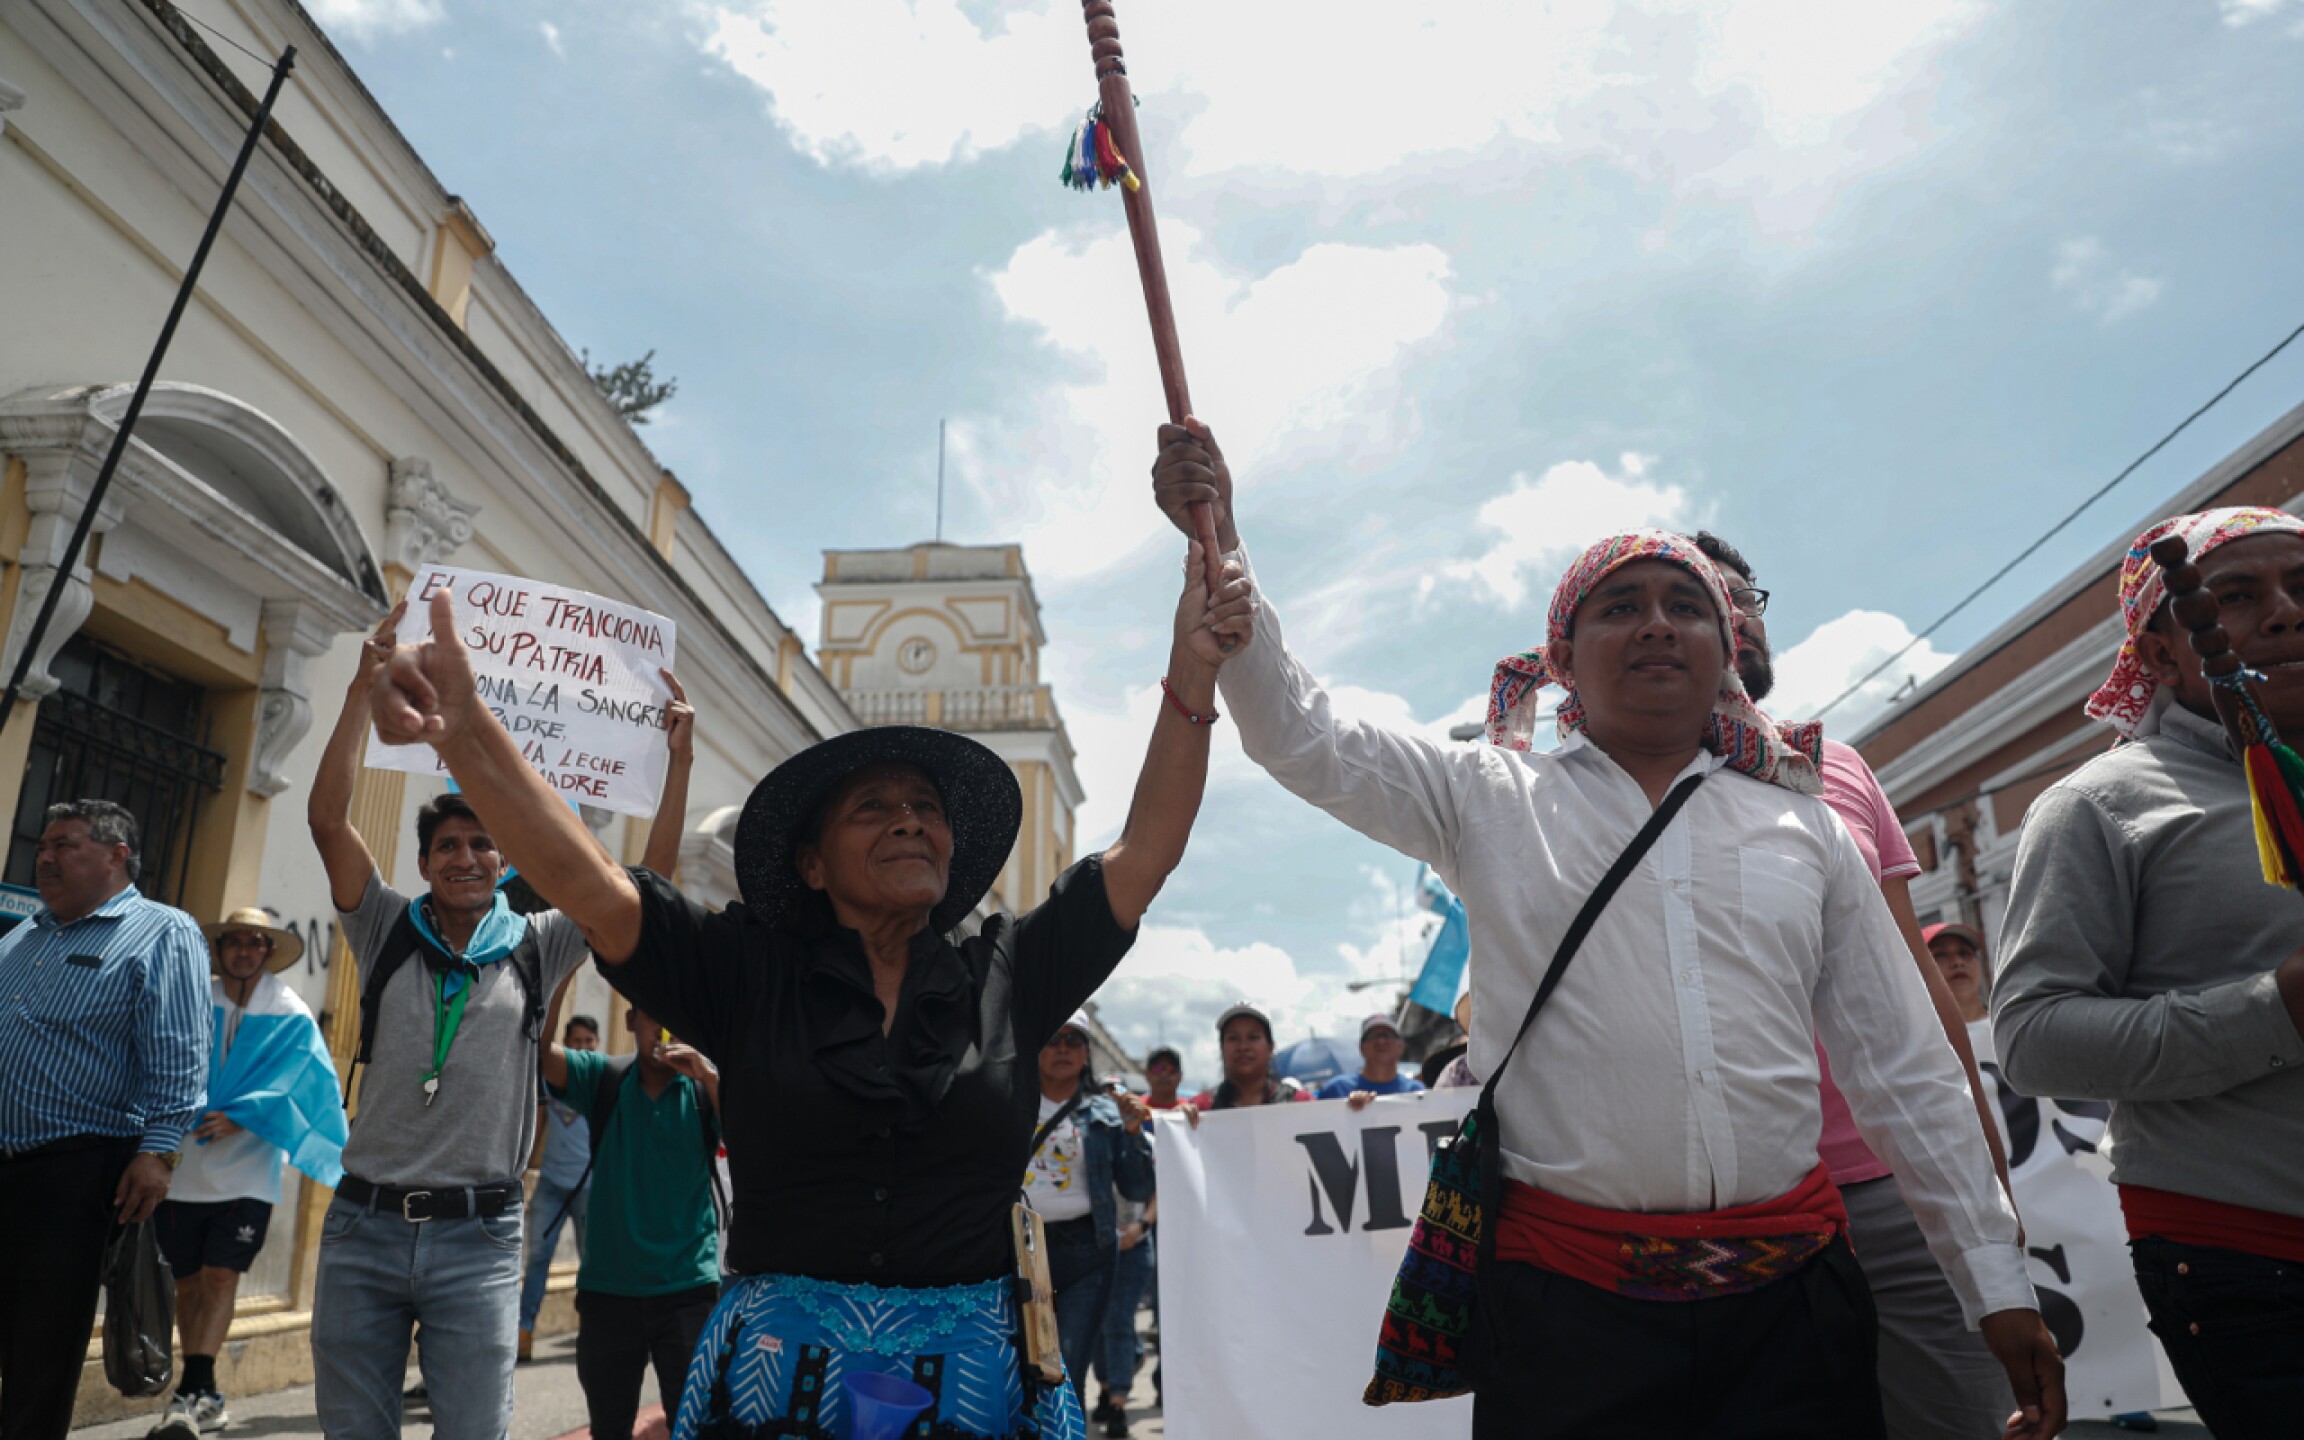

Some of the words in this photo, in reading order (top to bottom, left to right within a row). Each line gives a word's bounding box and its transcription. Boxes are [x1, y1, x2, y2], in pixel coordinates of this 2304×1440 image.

[468, 581, 529, 617] QUE
[541, 596, 665, 658] TRAICIONA
[526, 681, 559, 713] LA
[577, 688, 667, 730] SANGRE
[522, 740, 545, 764] LA
[558, 748, 627, 776] LECHE
